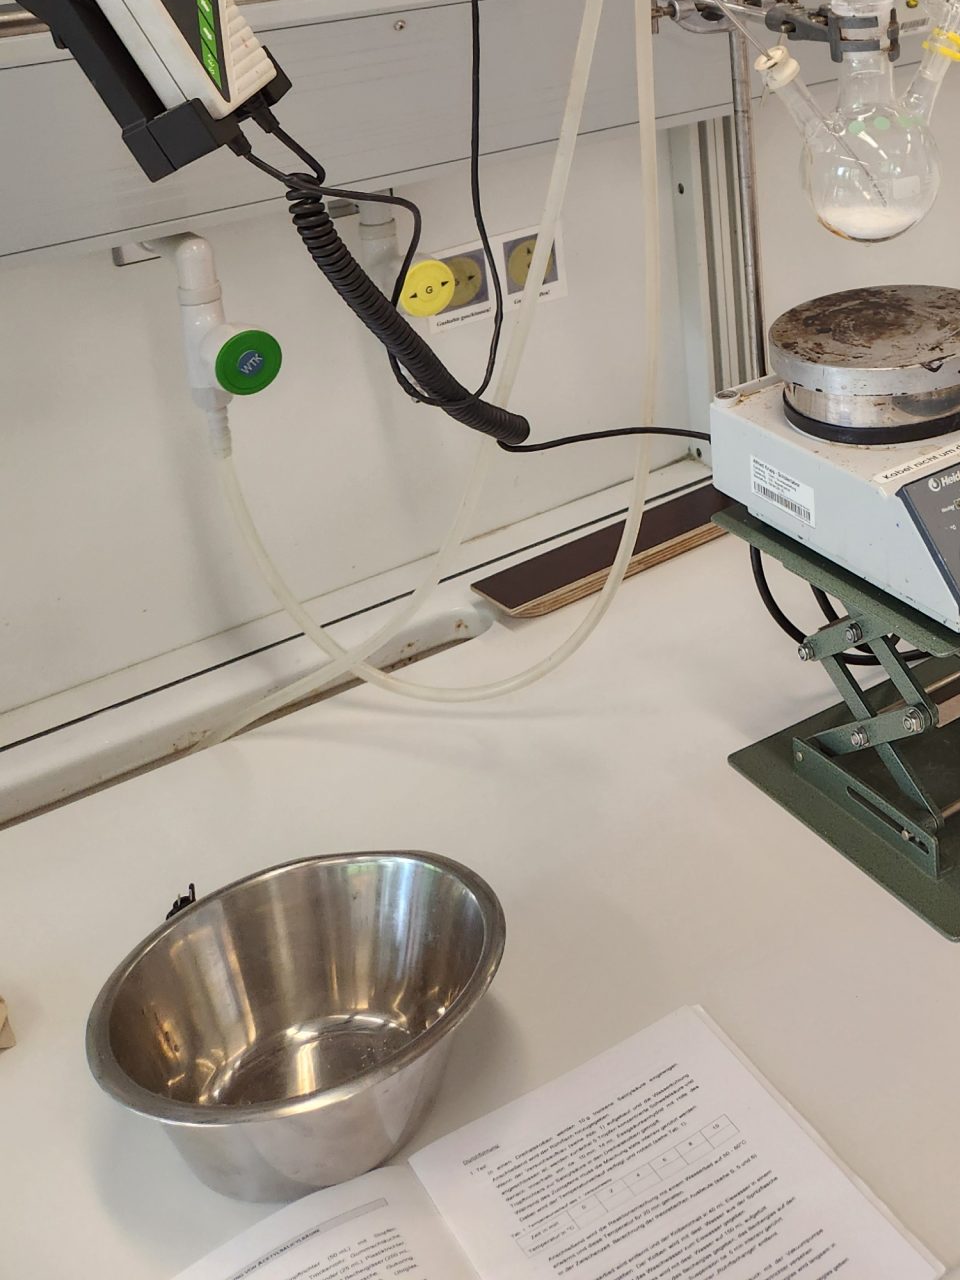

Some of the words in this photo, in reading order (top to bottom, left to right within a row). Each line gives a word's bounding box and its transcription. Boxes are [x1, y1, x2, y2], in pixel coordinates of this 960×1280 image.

[426, 286, 433, 294] G
[240, 353, 263, 374] WTK
[882, 464, 910, 481] Kabel
[913, 454, 938, 468] nicht
[939, 448, 954, 457] um
